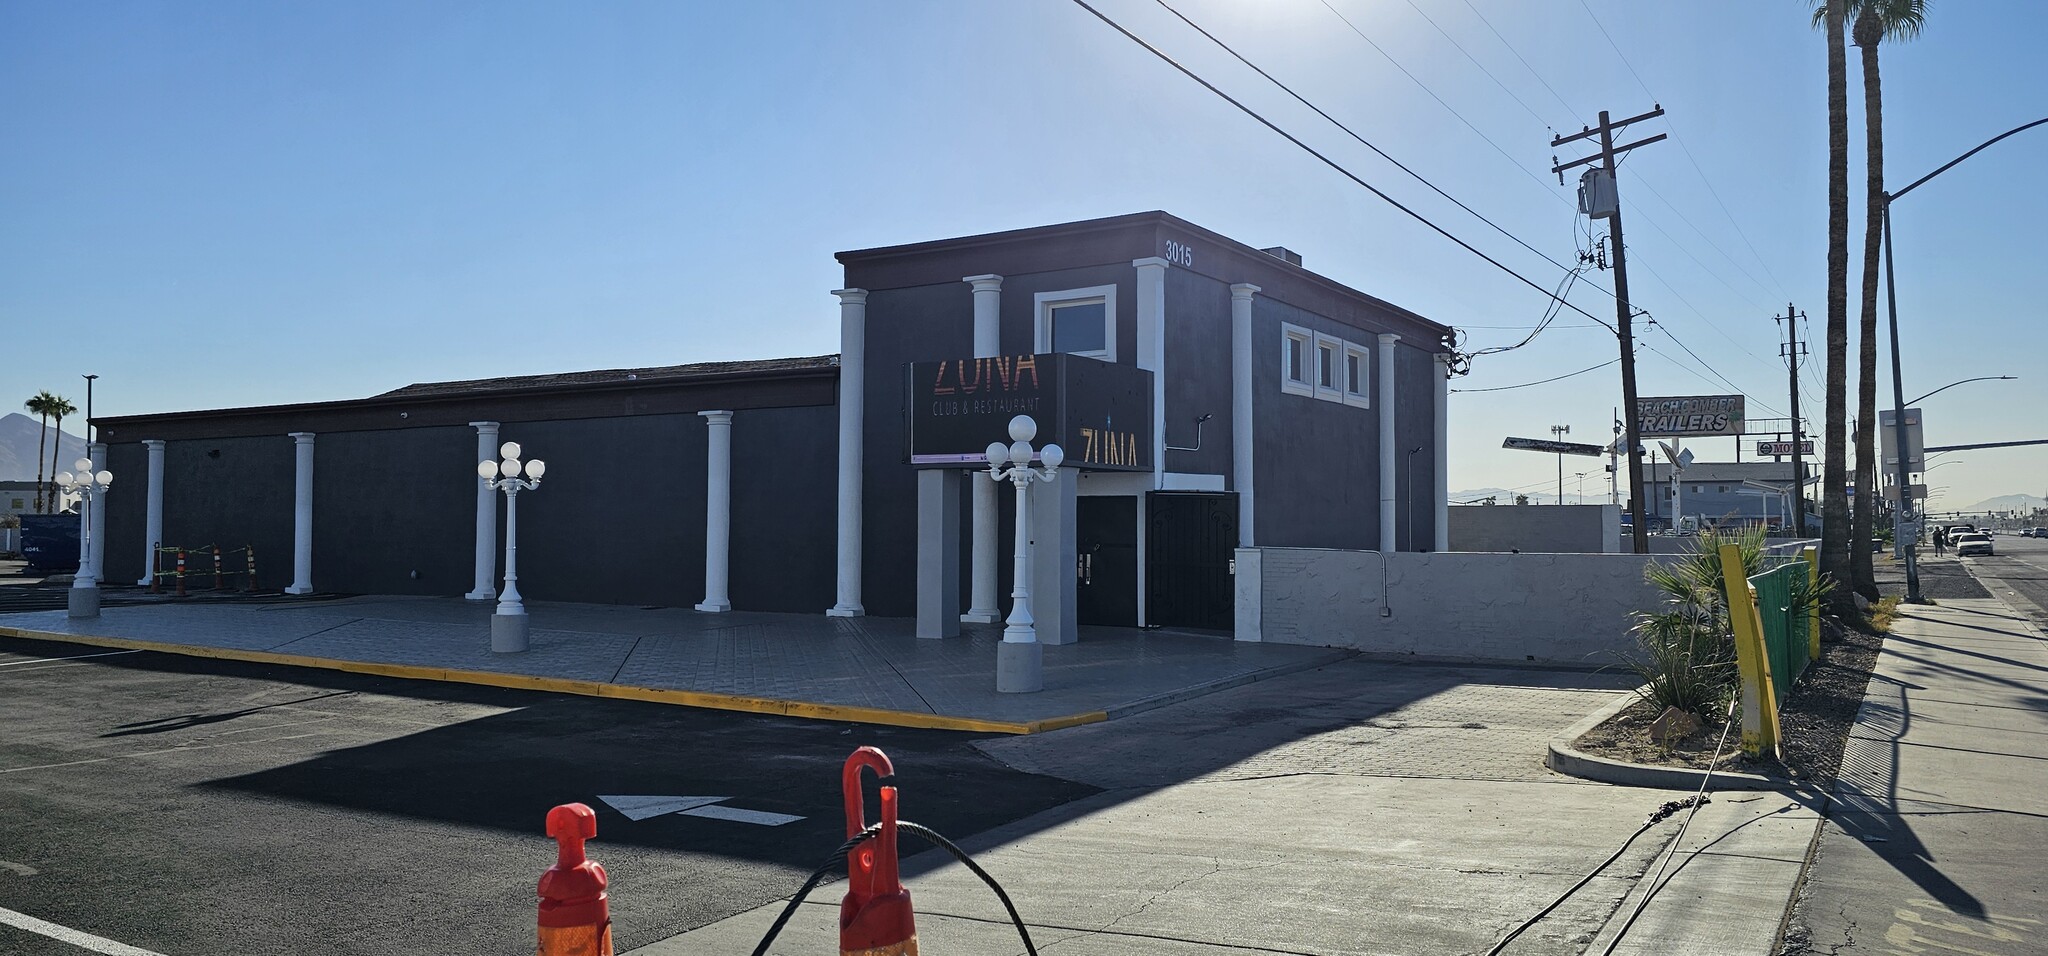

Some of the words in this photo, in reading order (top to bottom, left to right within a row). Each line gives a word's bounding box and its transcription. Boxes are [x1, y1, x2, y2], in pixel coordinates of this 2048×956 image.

[1165, 239, 1192, 267] 3015
[932, 401, 958, 417] CLUB
[962, 400, 969, 415] &
[974, 397, 1040, 414] RESTAURANT
